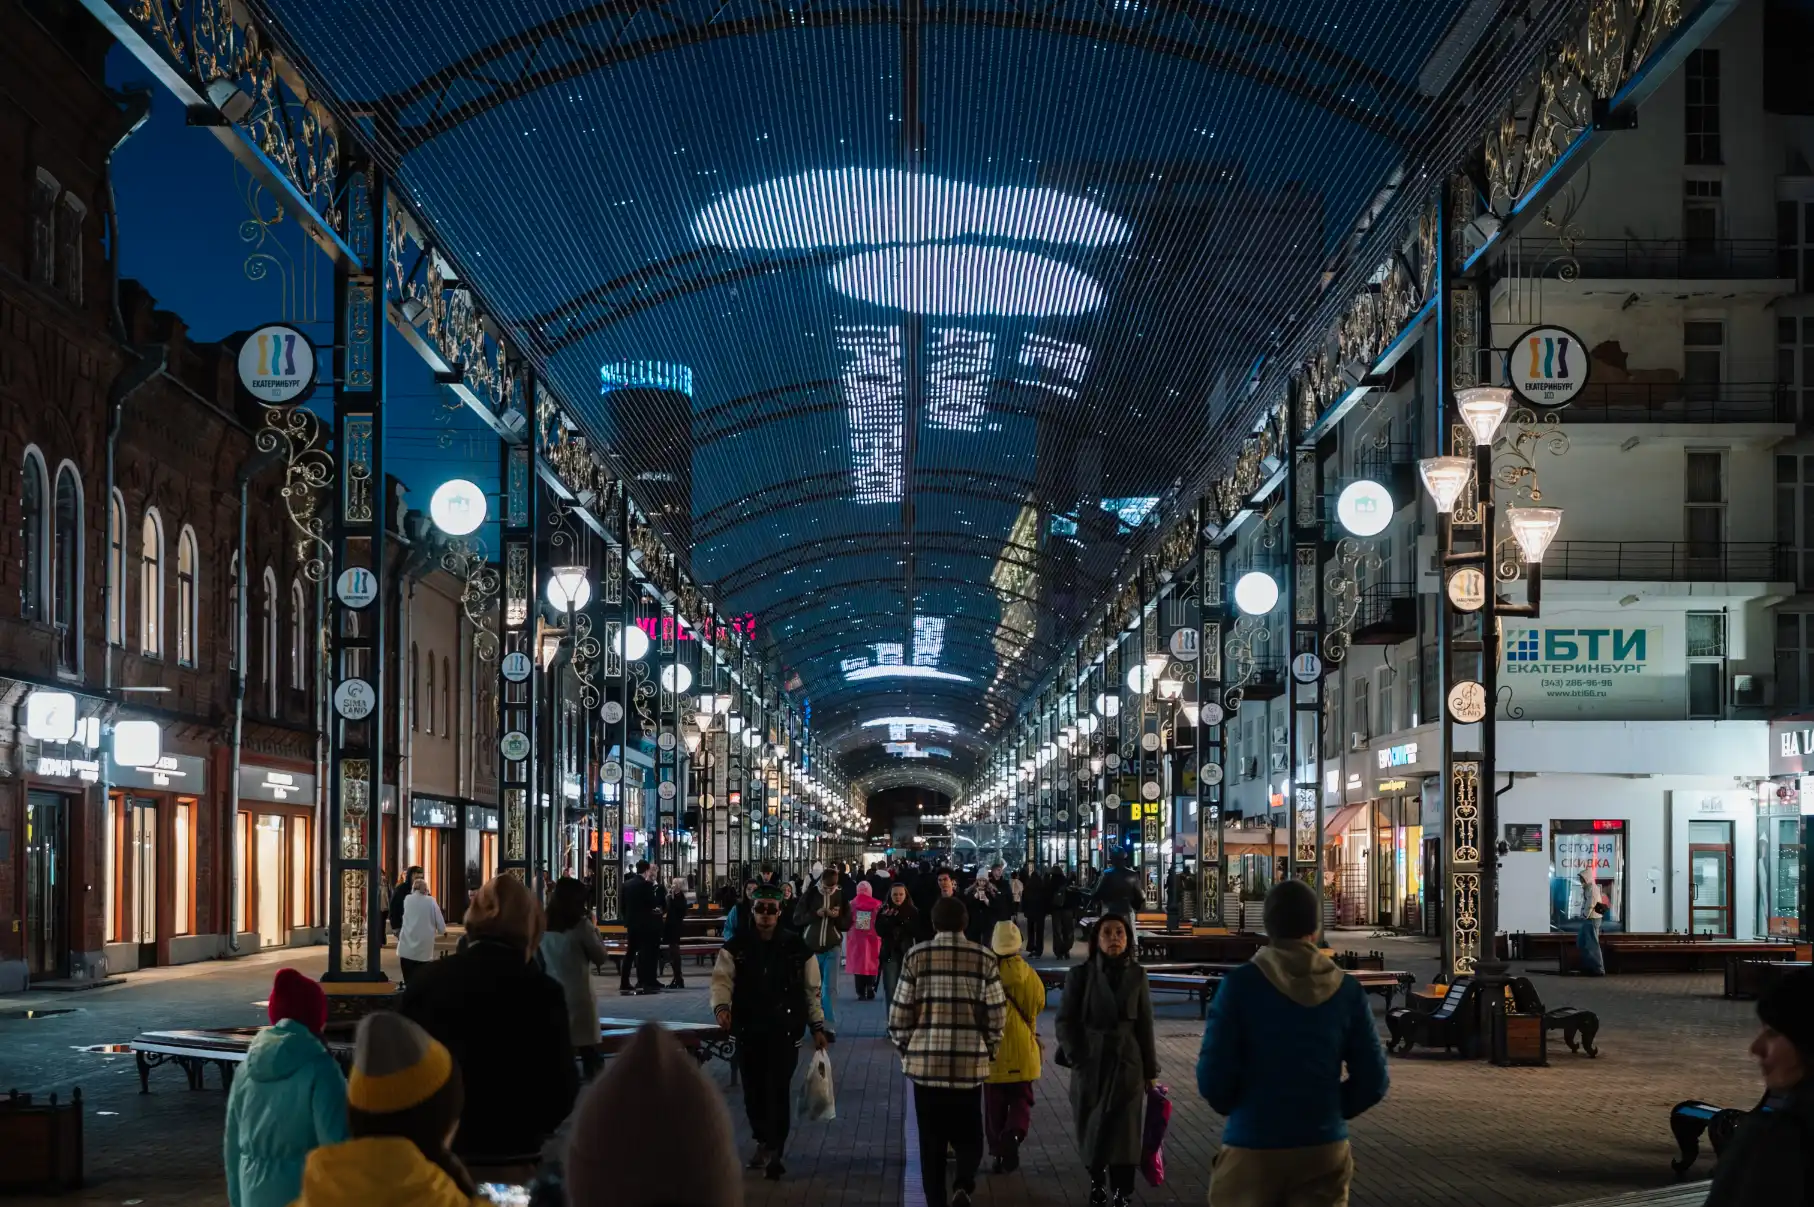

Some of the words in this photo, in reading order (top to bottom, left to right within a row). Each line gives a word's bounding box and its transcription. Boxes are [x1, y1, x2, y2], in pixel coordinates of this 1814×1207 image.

[252, 380, 300, 388] ЕКАТЕРИНБУРГ
[1525, 383, 1574, 391] ЕКАТЕРИНБУРГ
[1545, 629, 1646, 661] БТИ
[1507, 664, 1647, 674] ЕКАТЕРИНБУРГ
[1541, 679, 1563, 688] (343)
[1547, 690, 1607, 698] www.bti66.ru
[343, 706, 368, 715] LAND
[1558, 843, 1613, 854] СЕГОДНЯ
[1561, 858, 1610, 870] СКИДКА
